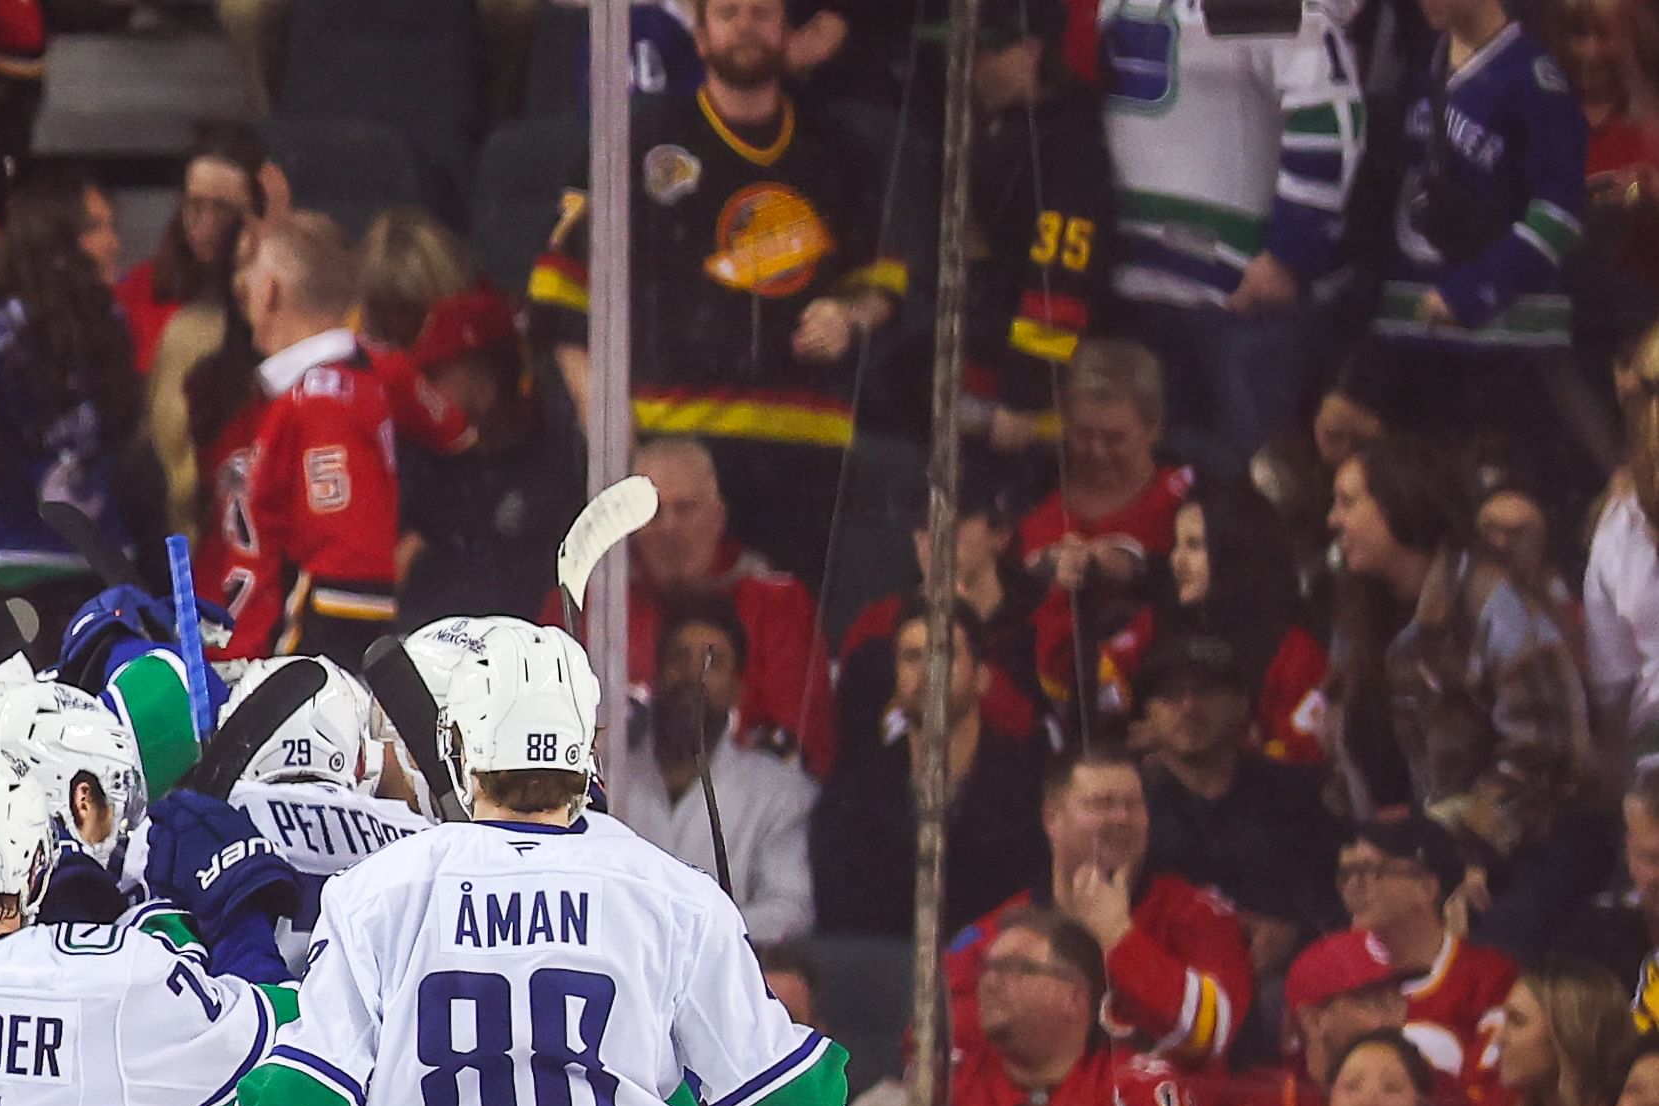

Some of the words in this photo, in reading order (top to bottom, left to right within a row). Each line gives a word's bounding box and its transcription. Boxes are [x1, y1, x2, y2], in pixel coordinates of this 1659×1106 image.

[1029, 209, 1095, 272] 35
[282, 738, 311, 767] 29
[527, 733, 558, 761] 88
[454, 882, 589, 948] ÅMAN
